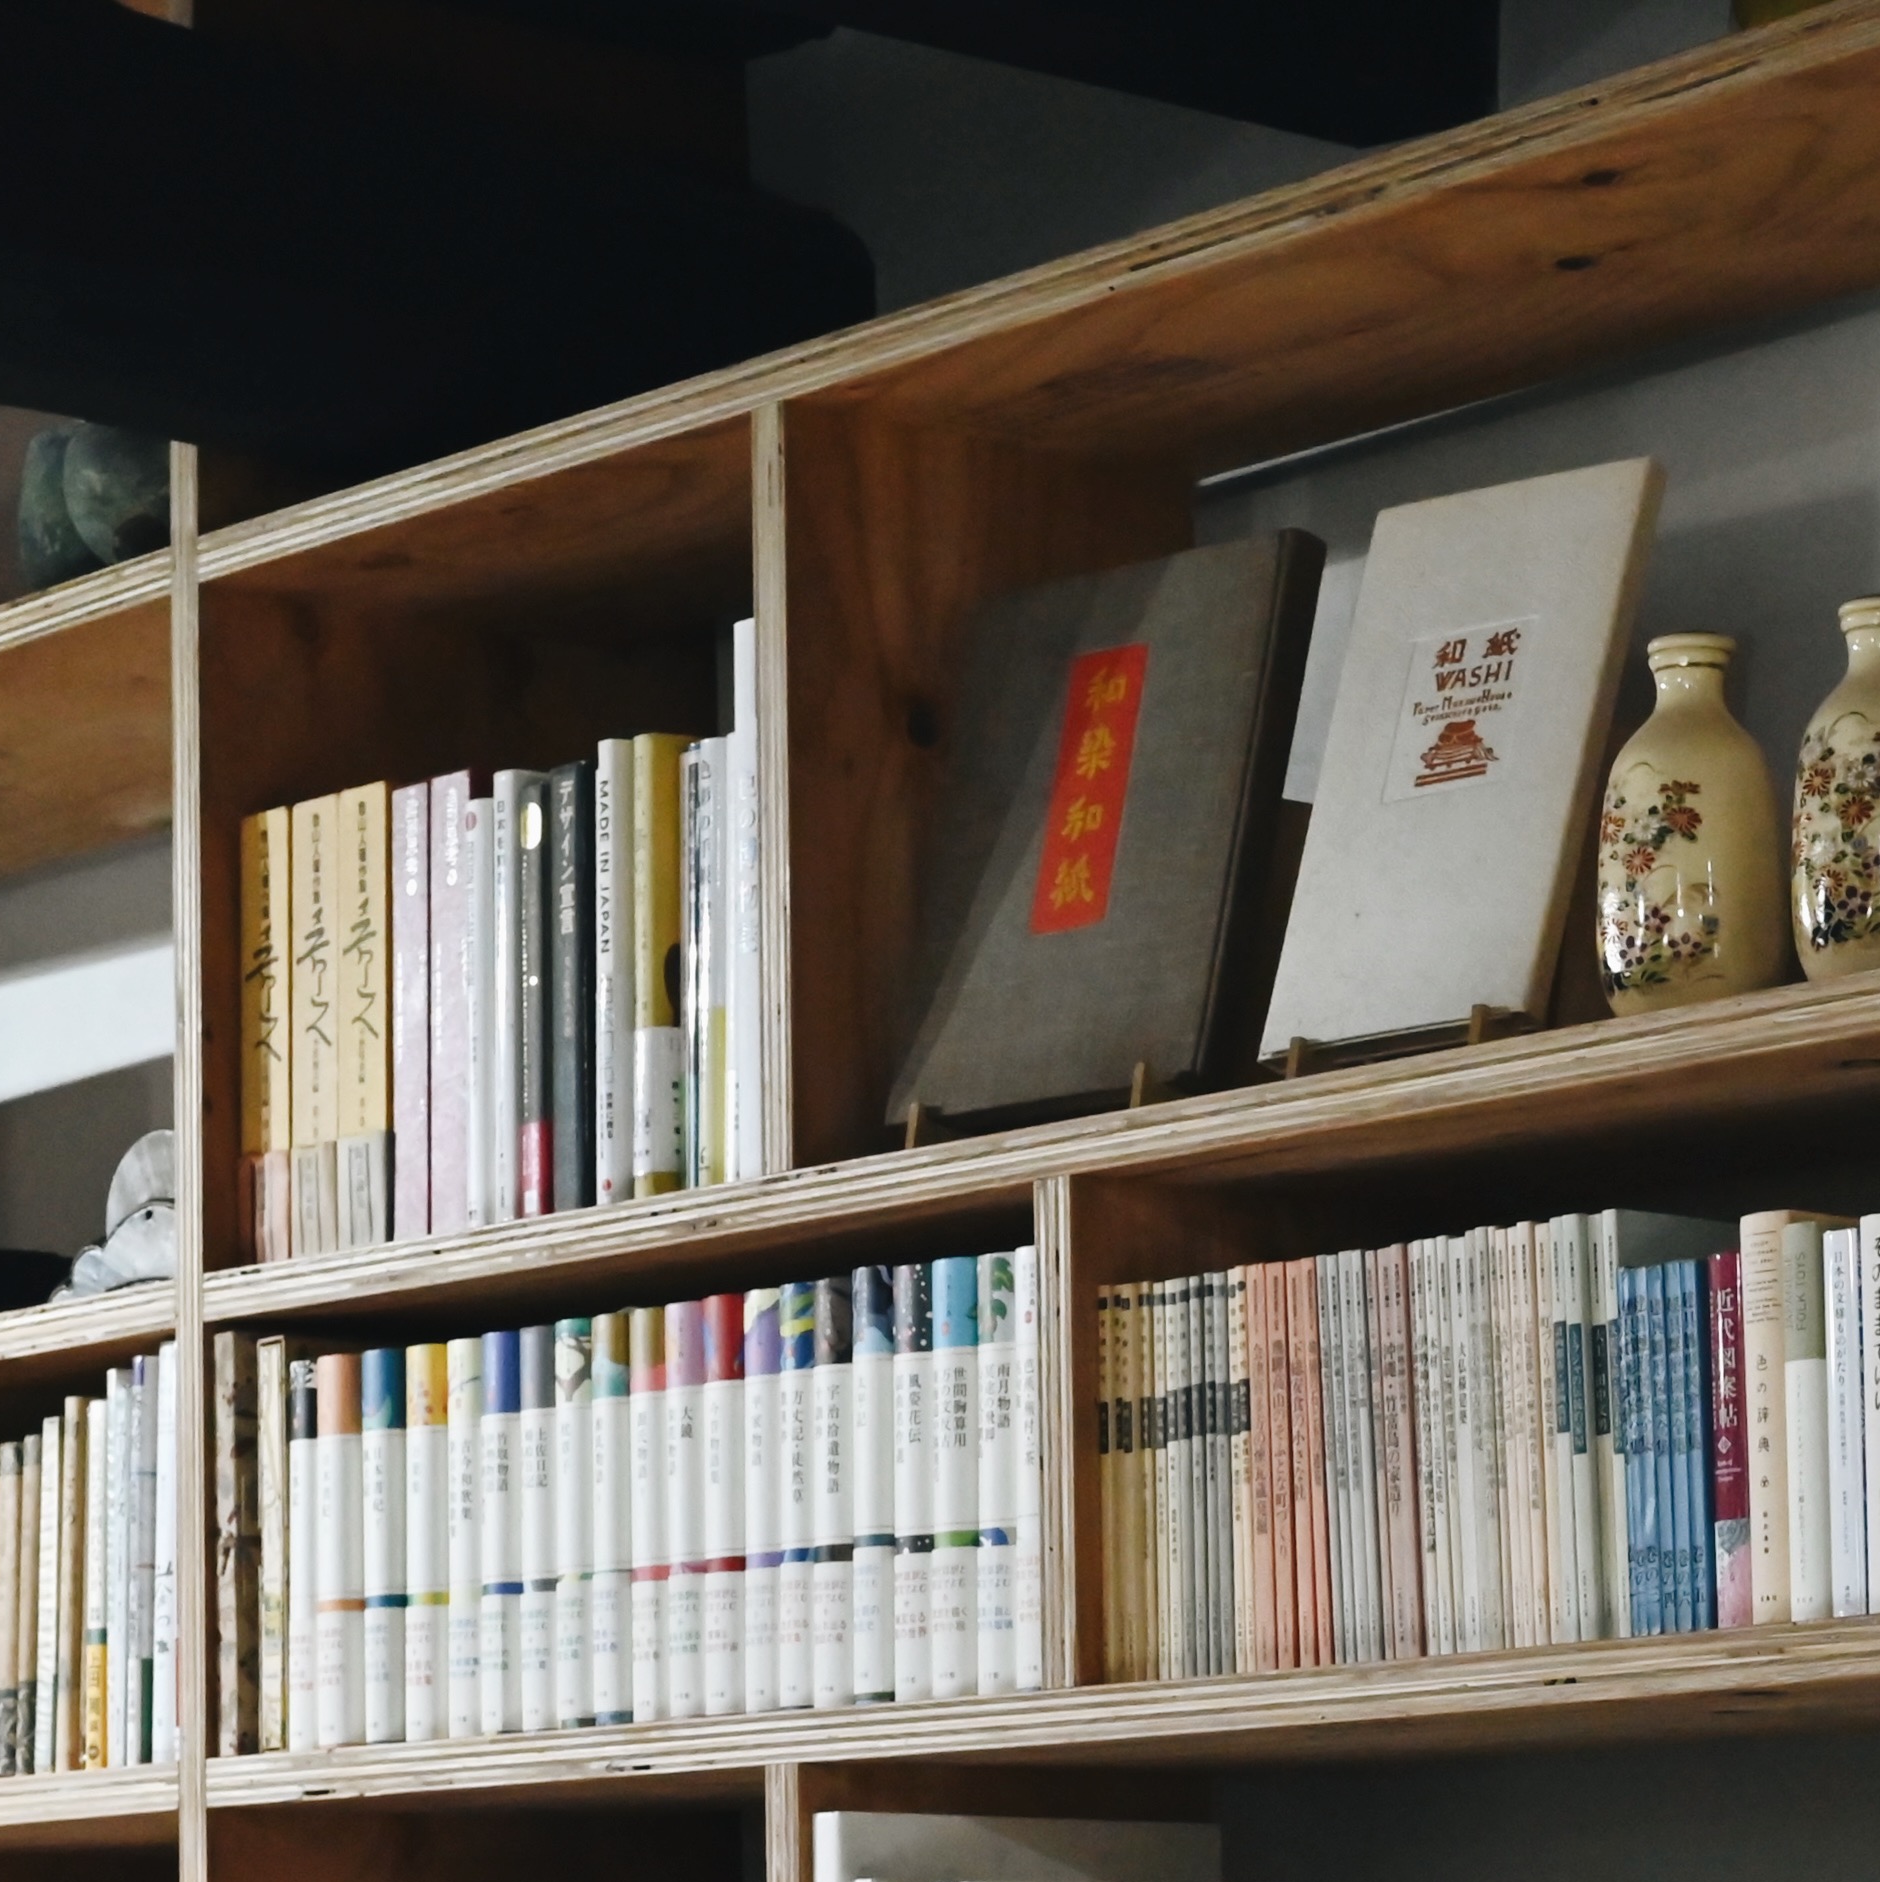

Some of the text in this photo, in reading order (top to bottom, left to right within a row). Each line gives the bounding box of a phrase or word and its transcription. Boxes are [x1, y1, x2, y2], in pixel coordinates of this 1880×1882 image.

[1435, 660, 1513, 692] WASHI
[599, 780, 610, 954] MADE IN JAPAN
